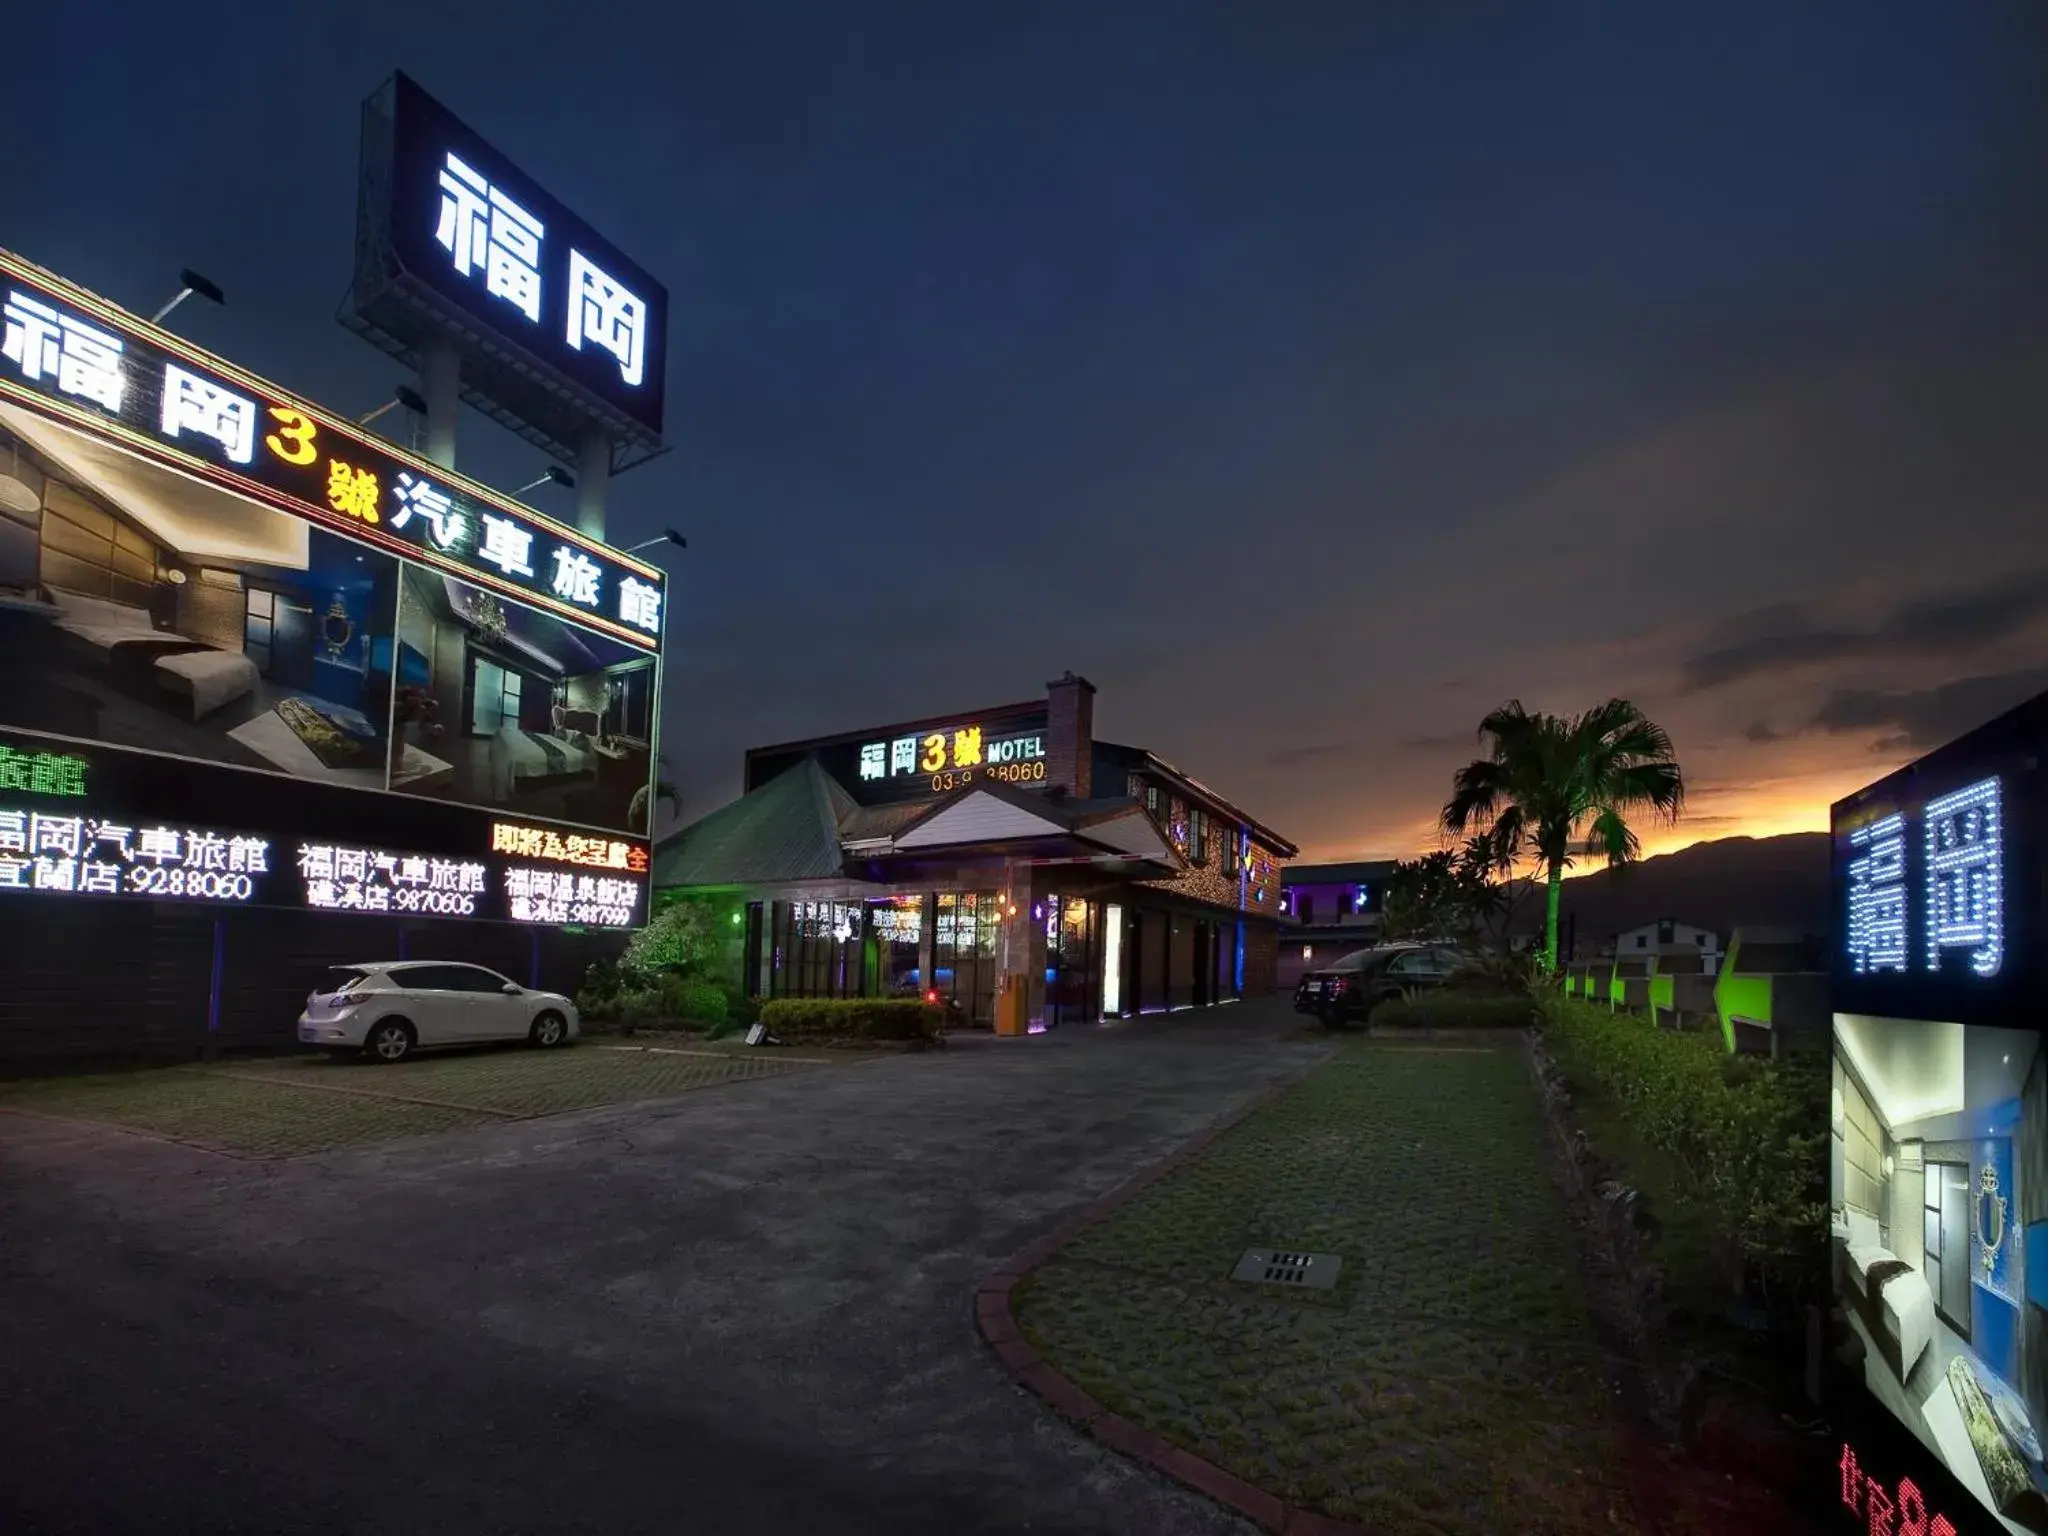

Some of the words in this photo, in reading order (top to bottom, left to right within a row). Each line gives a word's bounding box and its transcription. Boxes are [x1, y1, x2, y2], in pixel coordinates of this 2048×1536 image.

[434, 151, 646, 386] 福岡
[987, 737, 1046, 764] MOTEL
[297, 843, 486, 893] 福岡汽車旅館
[1847, 774, 2004, 978] 福岡
